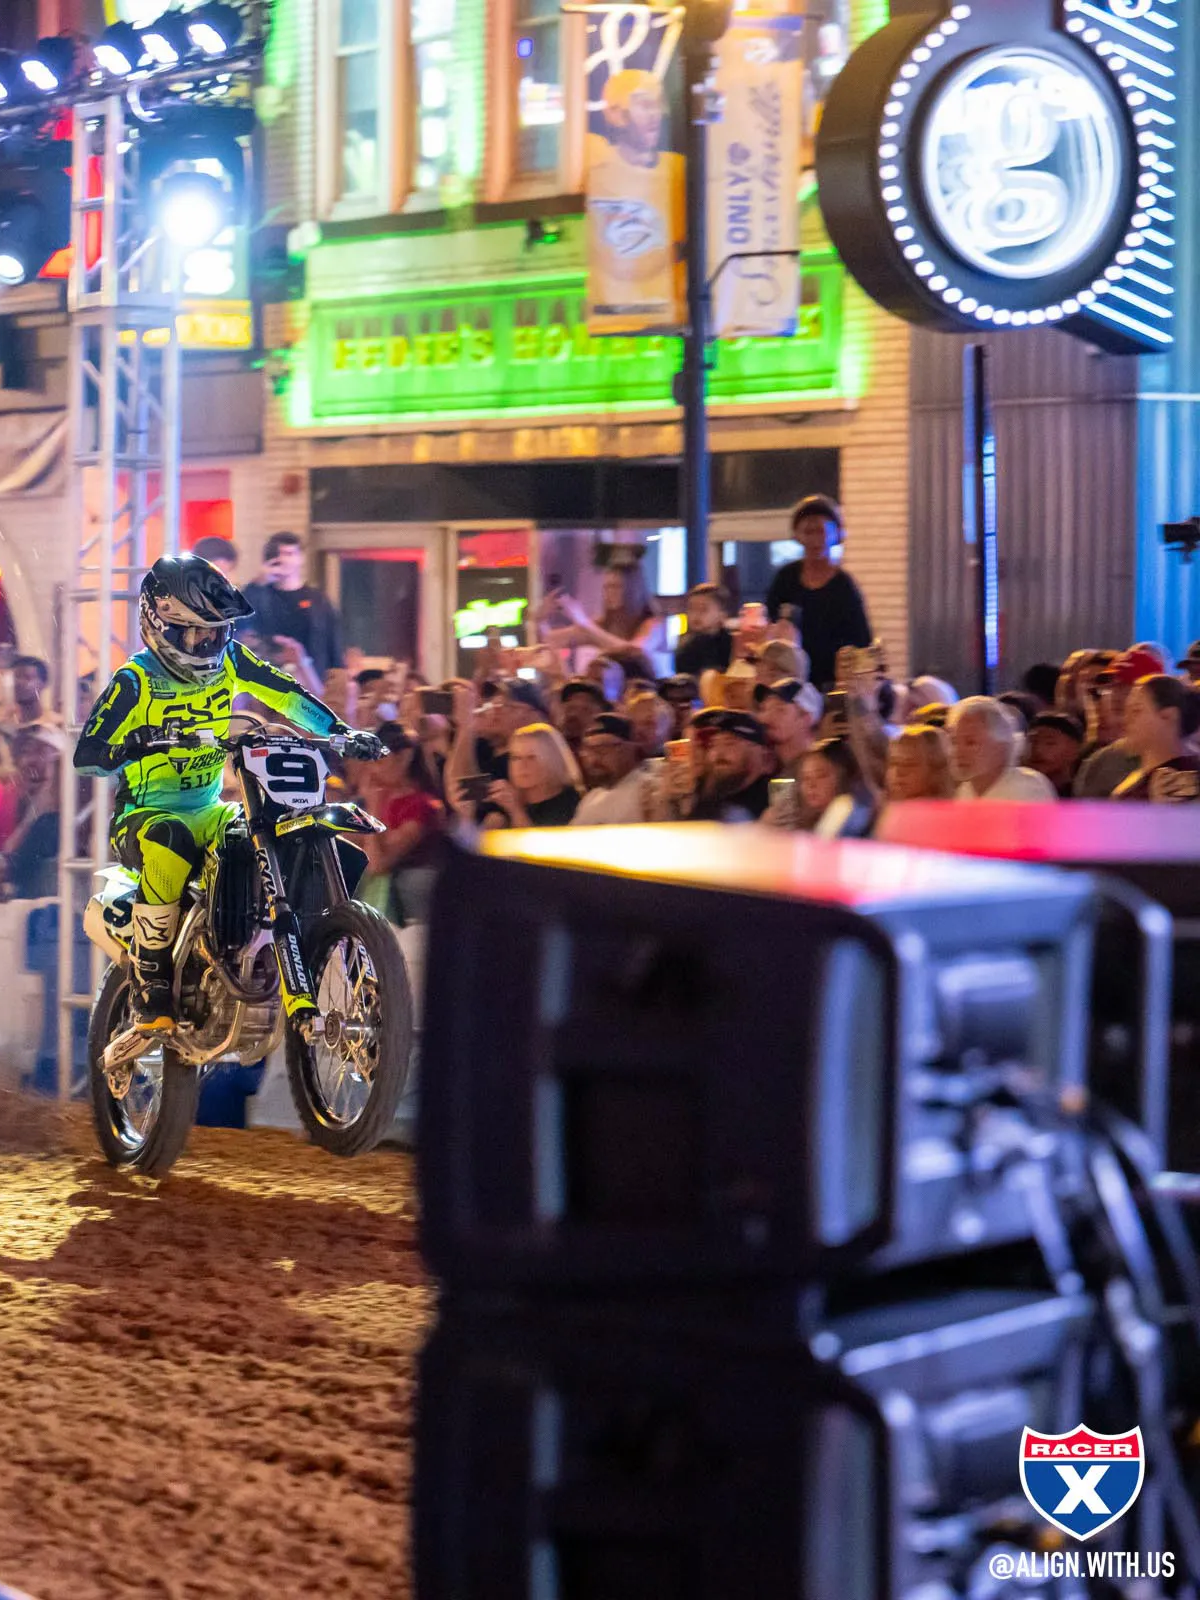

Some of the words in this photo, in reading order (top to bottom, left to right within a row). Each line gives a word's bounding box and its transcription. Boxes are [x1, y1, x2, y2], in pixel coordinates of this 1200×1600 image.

[727, 171, 751, 244] ONLY
[265, 753, 319, 793] 9
[288, 932, 310, 993] DUNLOP
